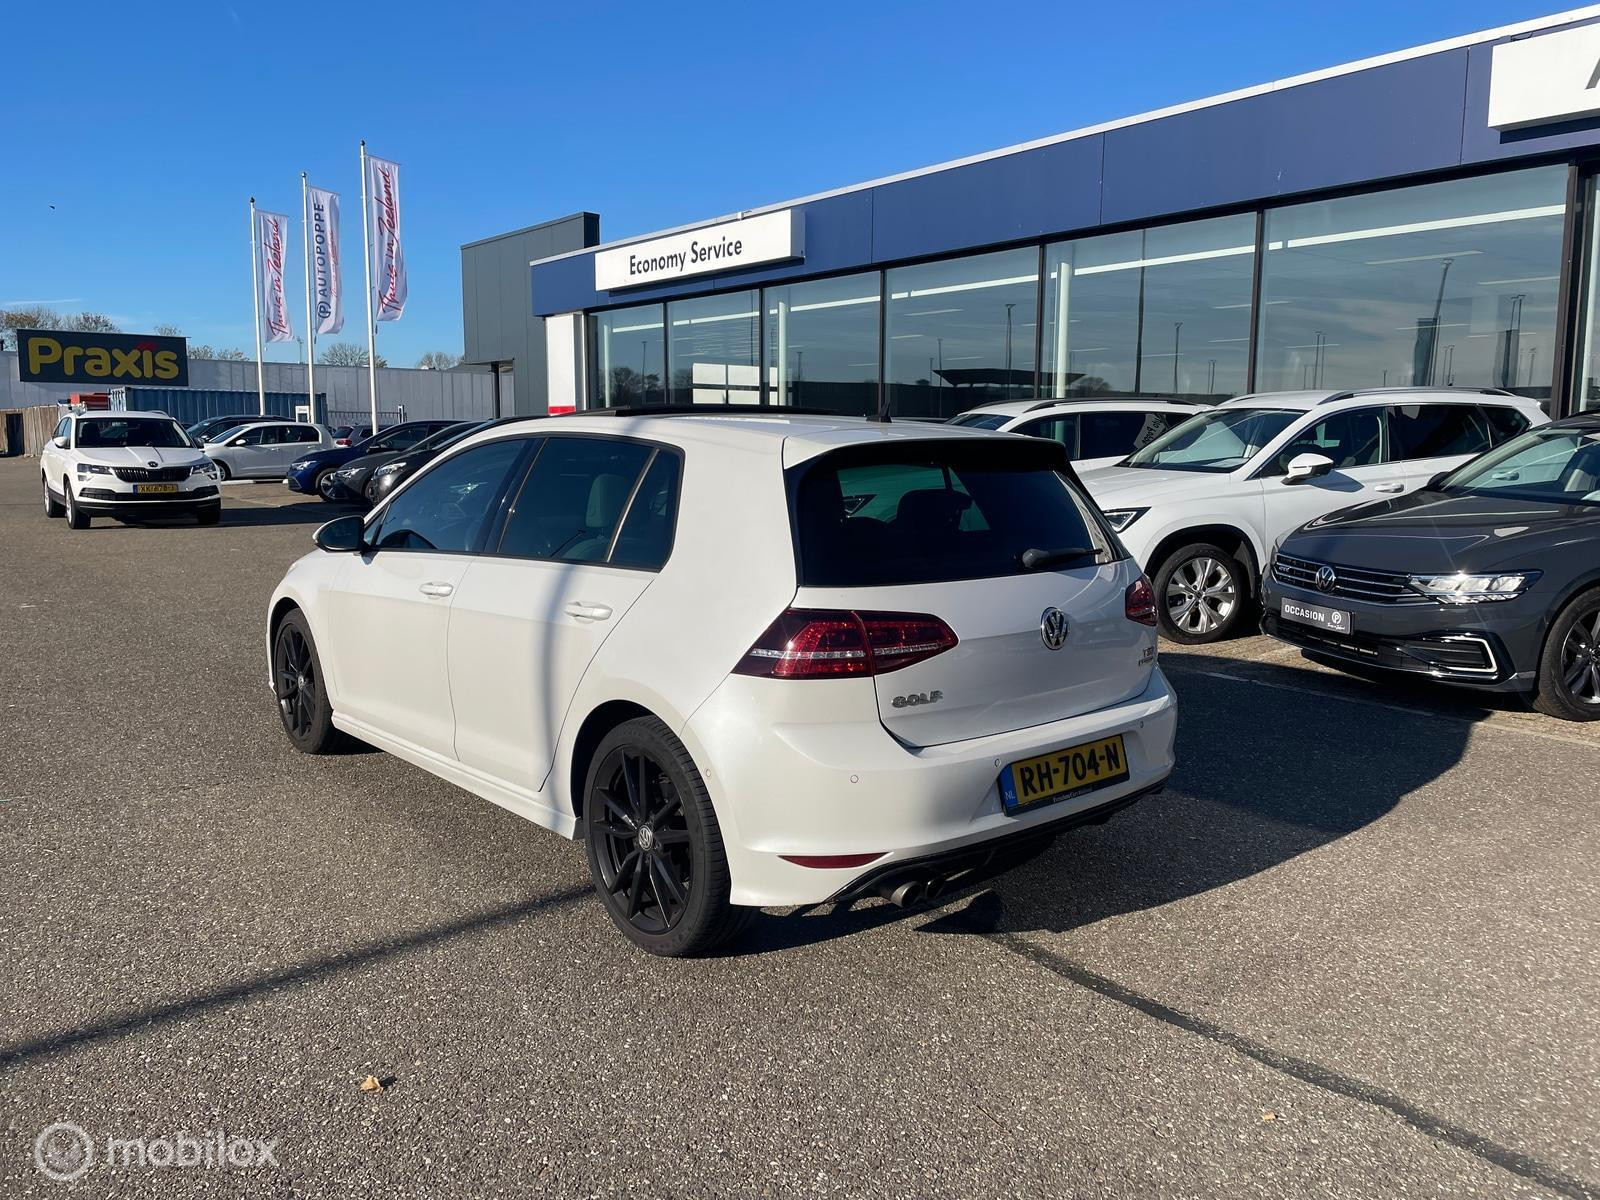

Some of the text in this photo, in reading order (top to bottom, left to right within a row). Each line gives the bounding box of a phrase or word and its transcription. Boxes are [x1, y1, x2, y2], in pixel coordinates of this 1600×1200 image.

[374, 167, 399, 243] Zeeland
[264, 219, 282, 276] Zeeland
[314, 203, 328, 298] AUTOPOPPE
[385, 240, 394, 259] in
[629, 236, 742, 275] Economy Service
[273, 277, 282, 292] in
[27, 337, 179, 380] Praxis
[1284, 604, 1325, 622] OCCASION
[891, 690, 943, 708] GOLF
[1020, 742, 1120, 797] RH-704-N
[1005, 791, 1016, 800] NL
